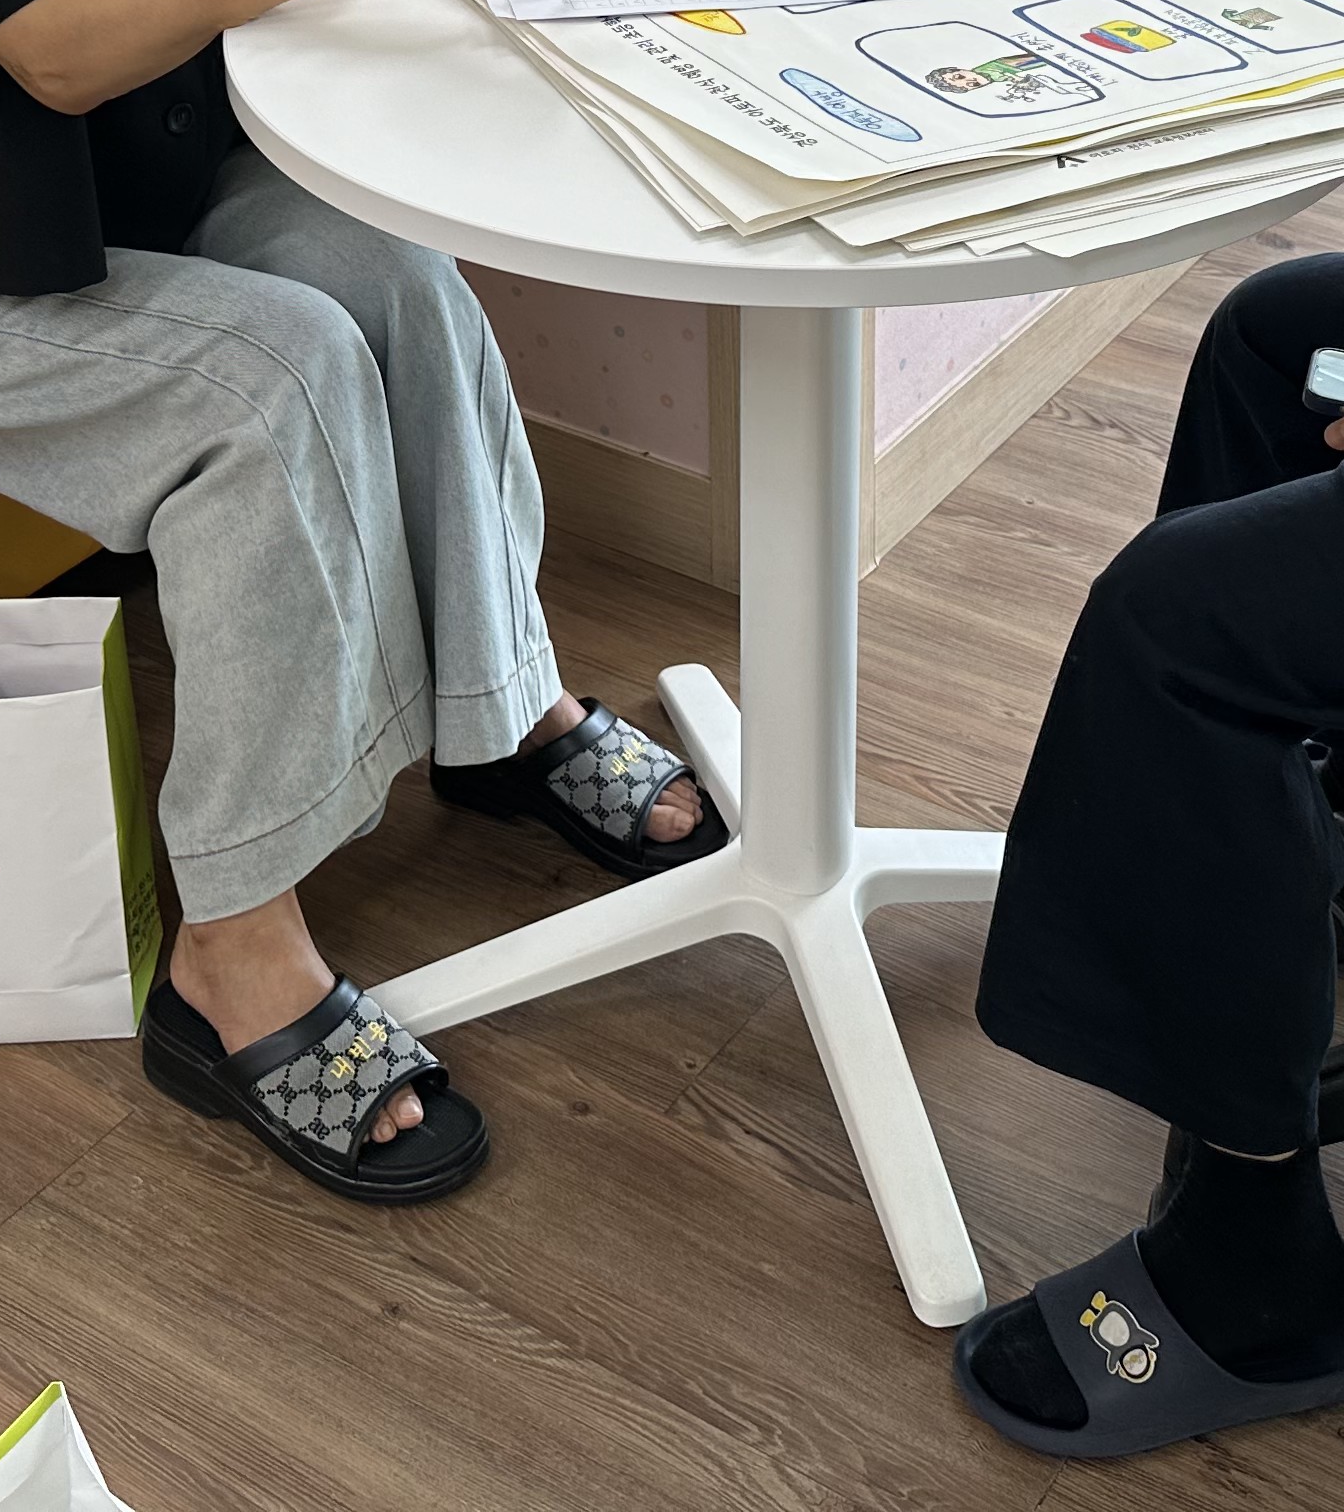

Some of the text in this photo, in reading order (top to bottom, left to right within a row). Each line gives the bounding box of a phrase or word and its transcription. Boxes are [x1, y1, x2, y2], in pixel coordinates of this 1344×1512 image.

[601, 15, 644, 39] 초등학
[632, 39, 668, 56] 관리
[656, 53, 682, 65] 및
[669, 63, 702, 80] 예방
[758, 116, 819, 148] 경상북도
[330, 1021, 387, 1079] 내빈용
